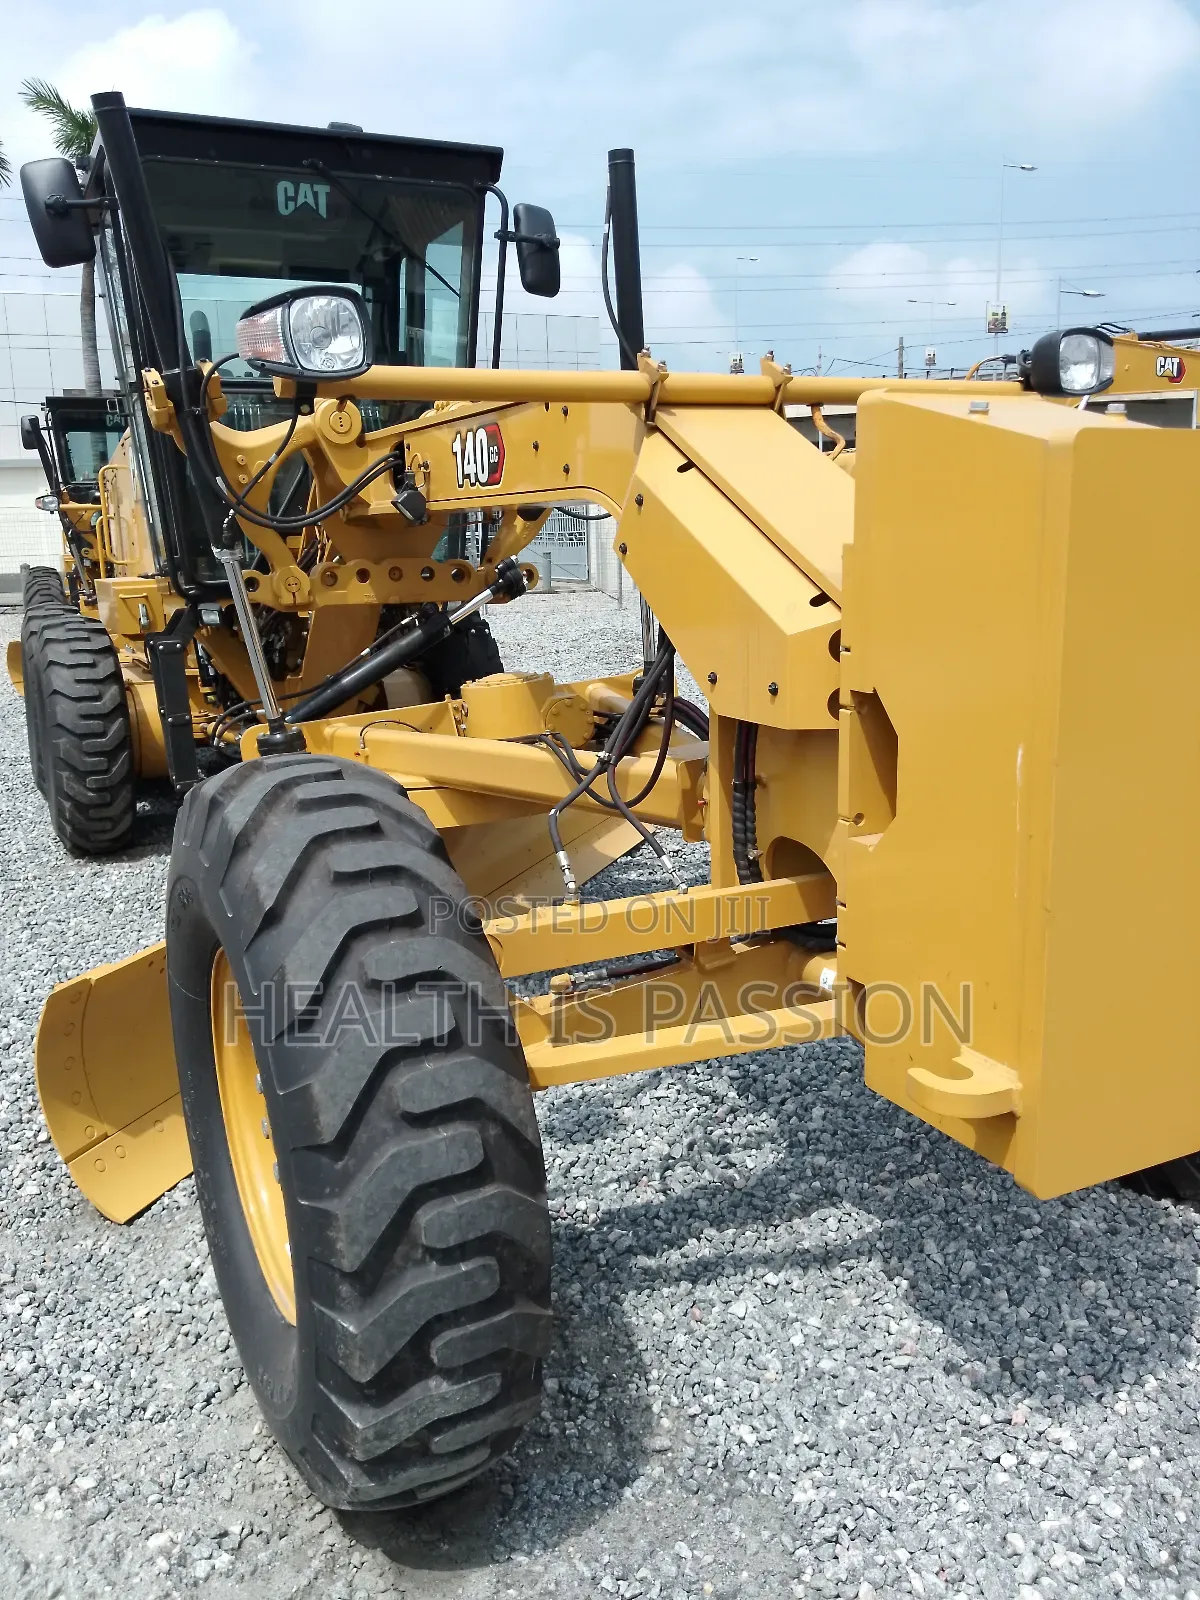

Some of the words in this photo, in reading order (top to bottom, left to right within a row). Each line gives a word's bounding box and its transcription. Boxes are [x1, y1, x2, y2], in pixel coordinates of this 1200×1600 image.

[277, 181, 330, 218] CAT
[1157, 356, 1179, 377] CAT
[452, 427, 489, 485] 140
[489, 445, 499, 463] GC
